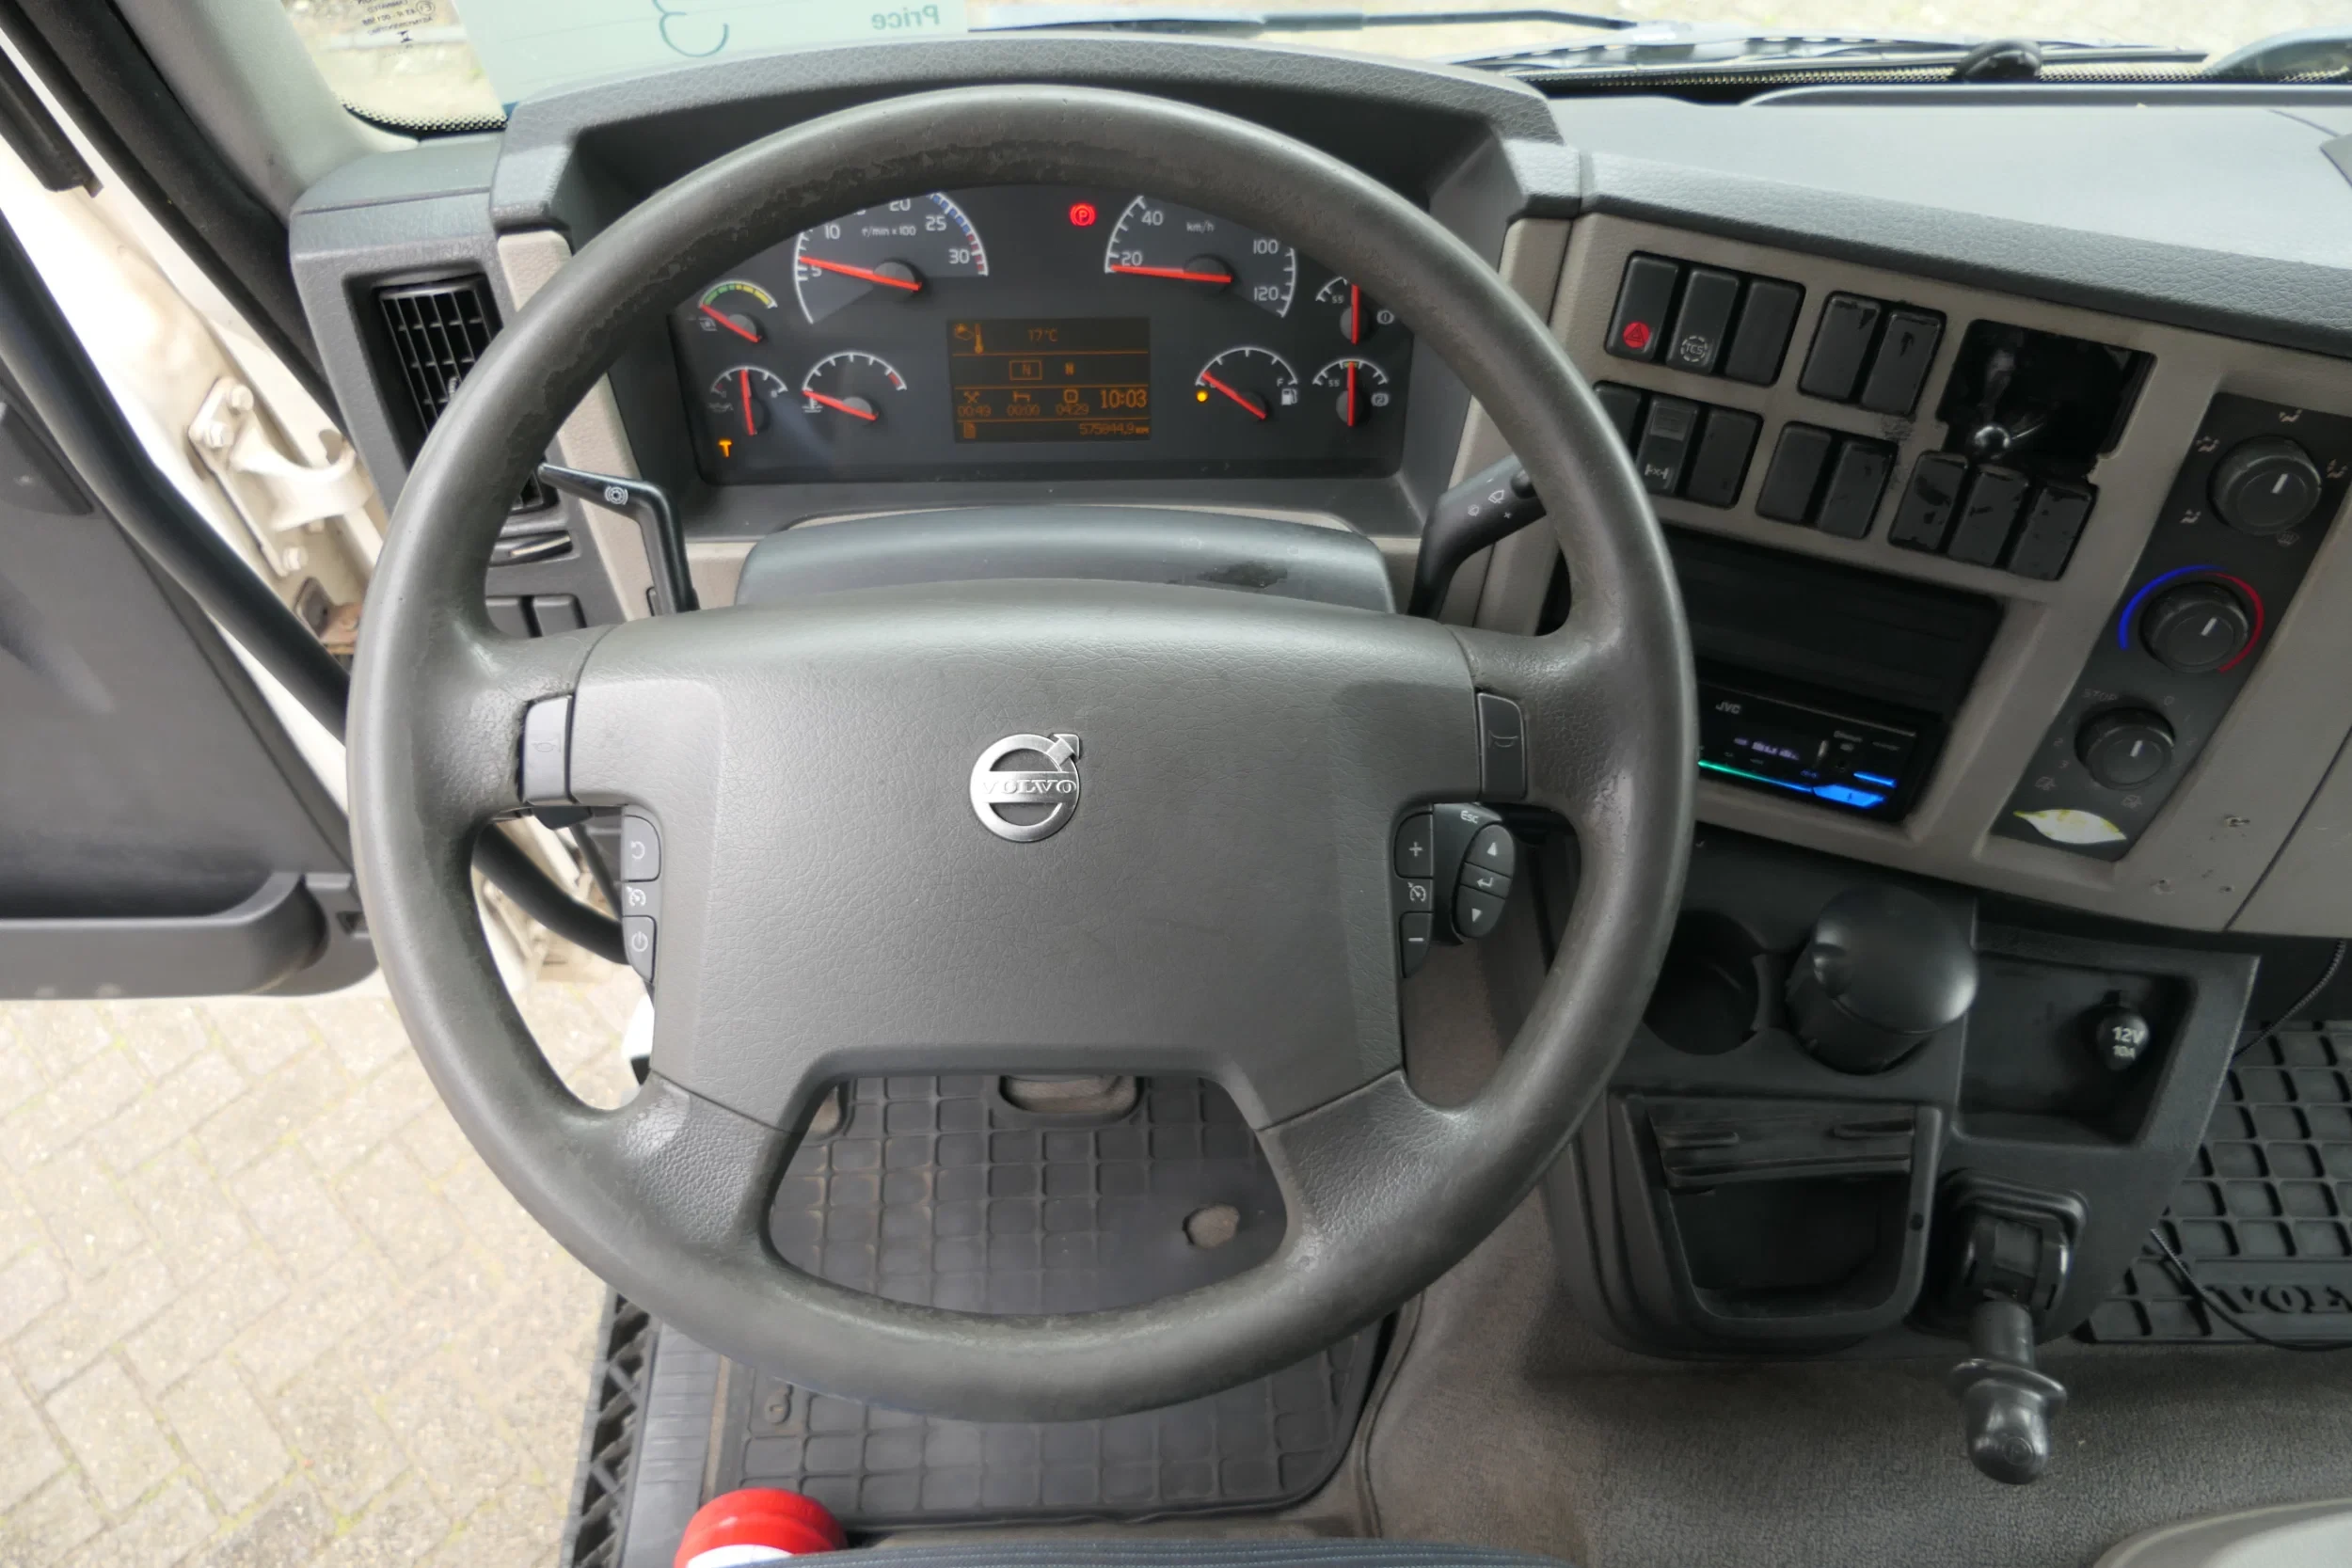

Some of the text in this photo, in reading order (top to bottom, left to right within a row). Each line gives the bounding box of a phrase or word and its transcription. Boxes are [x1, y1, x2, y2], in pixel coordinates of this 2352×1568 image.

[926, 214, 947, 231] 25
[1141, 211, 1164, 227] 40
[1186, 220, 1214, 233] km/h
[824, 225, 840, 240] 10
[899, 226, 916, 236] 100
[1253, 240, 1279, 255] 100
[948, 248, 970, 264] 30
[1121, 251, 1143, 267] 20
[1254, 286, 1279, 301] 120
[1680, 342, 1704, 356] TCS
[1277, 378, 1284, 388] F
[1101, 389, 1147, 408] 10:03
[1715, 701, 1740, 715] JVC
[982, 779, 1077, 794] VOLVO
[1460, 810, 1478, 824] Esc
[2111, 1026, 2144, 1045] 12V
